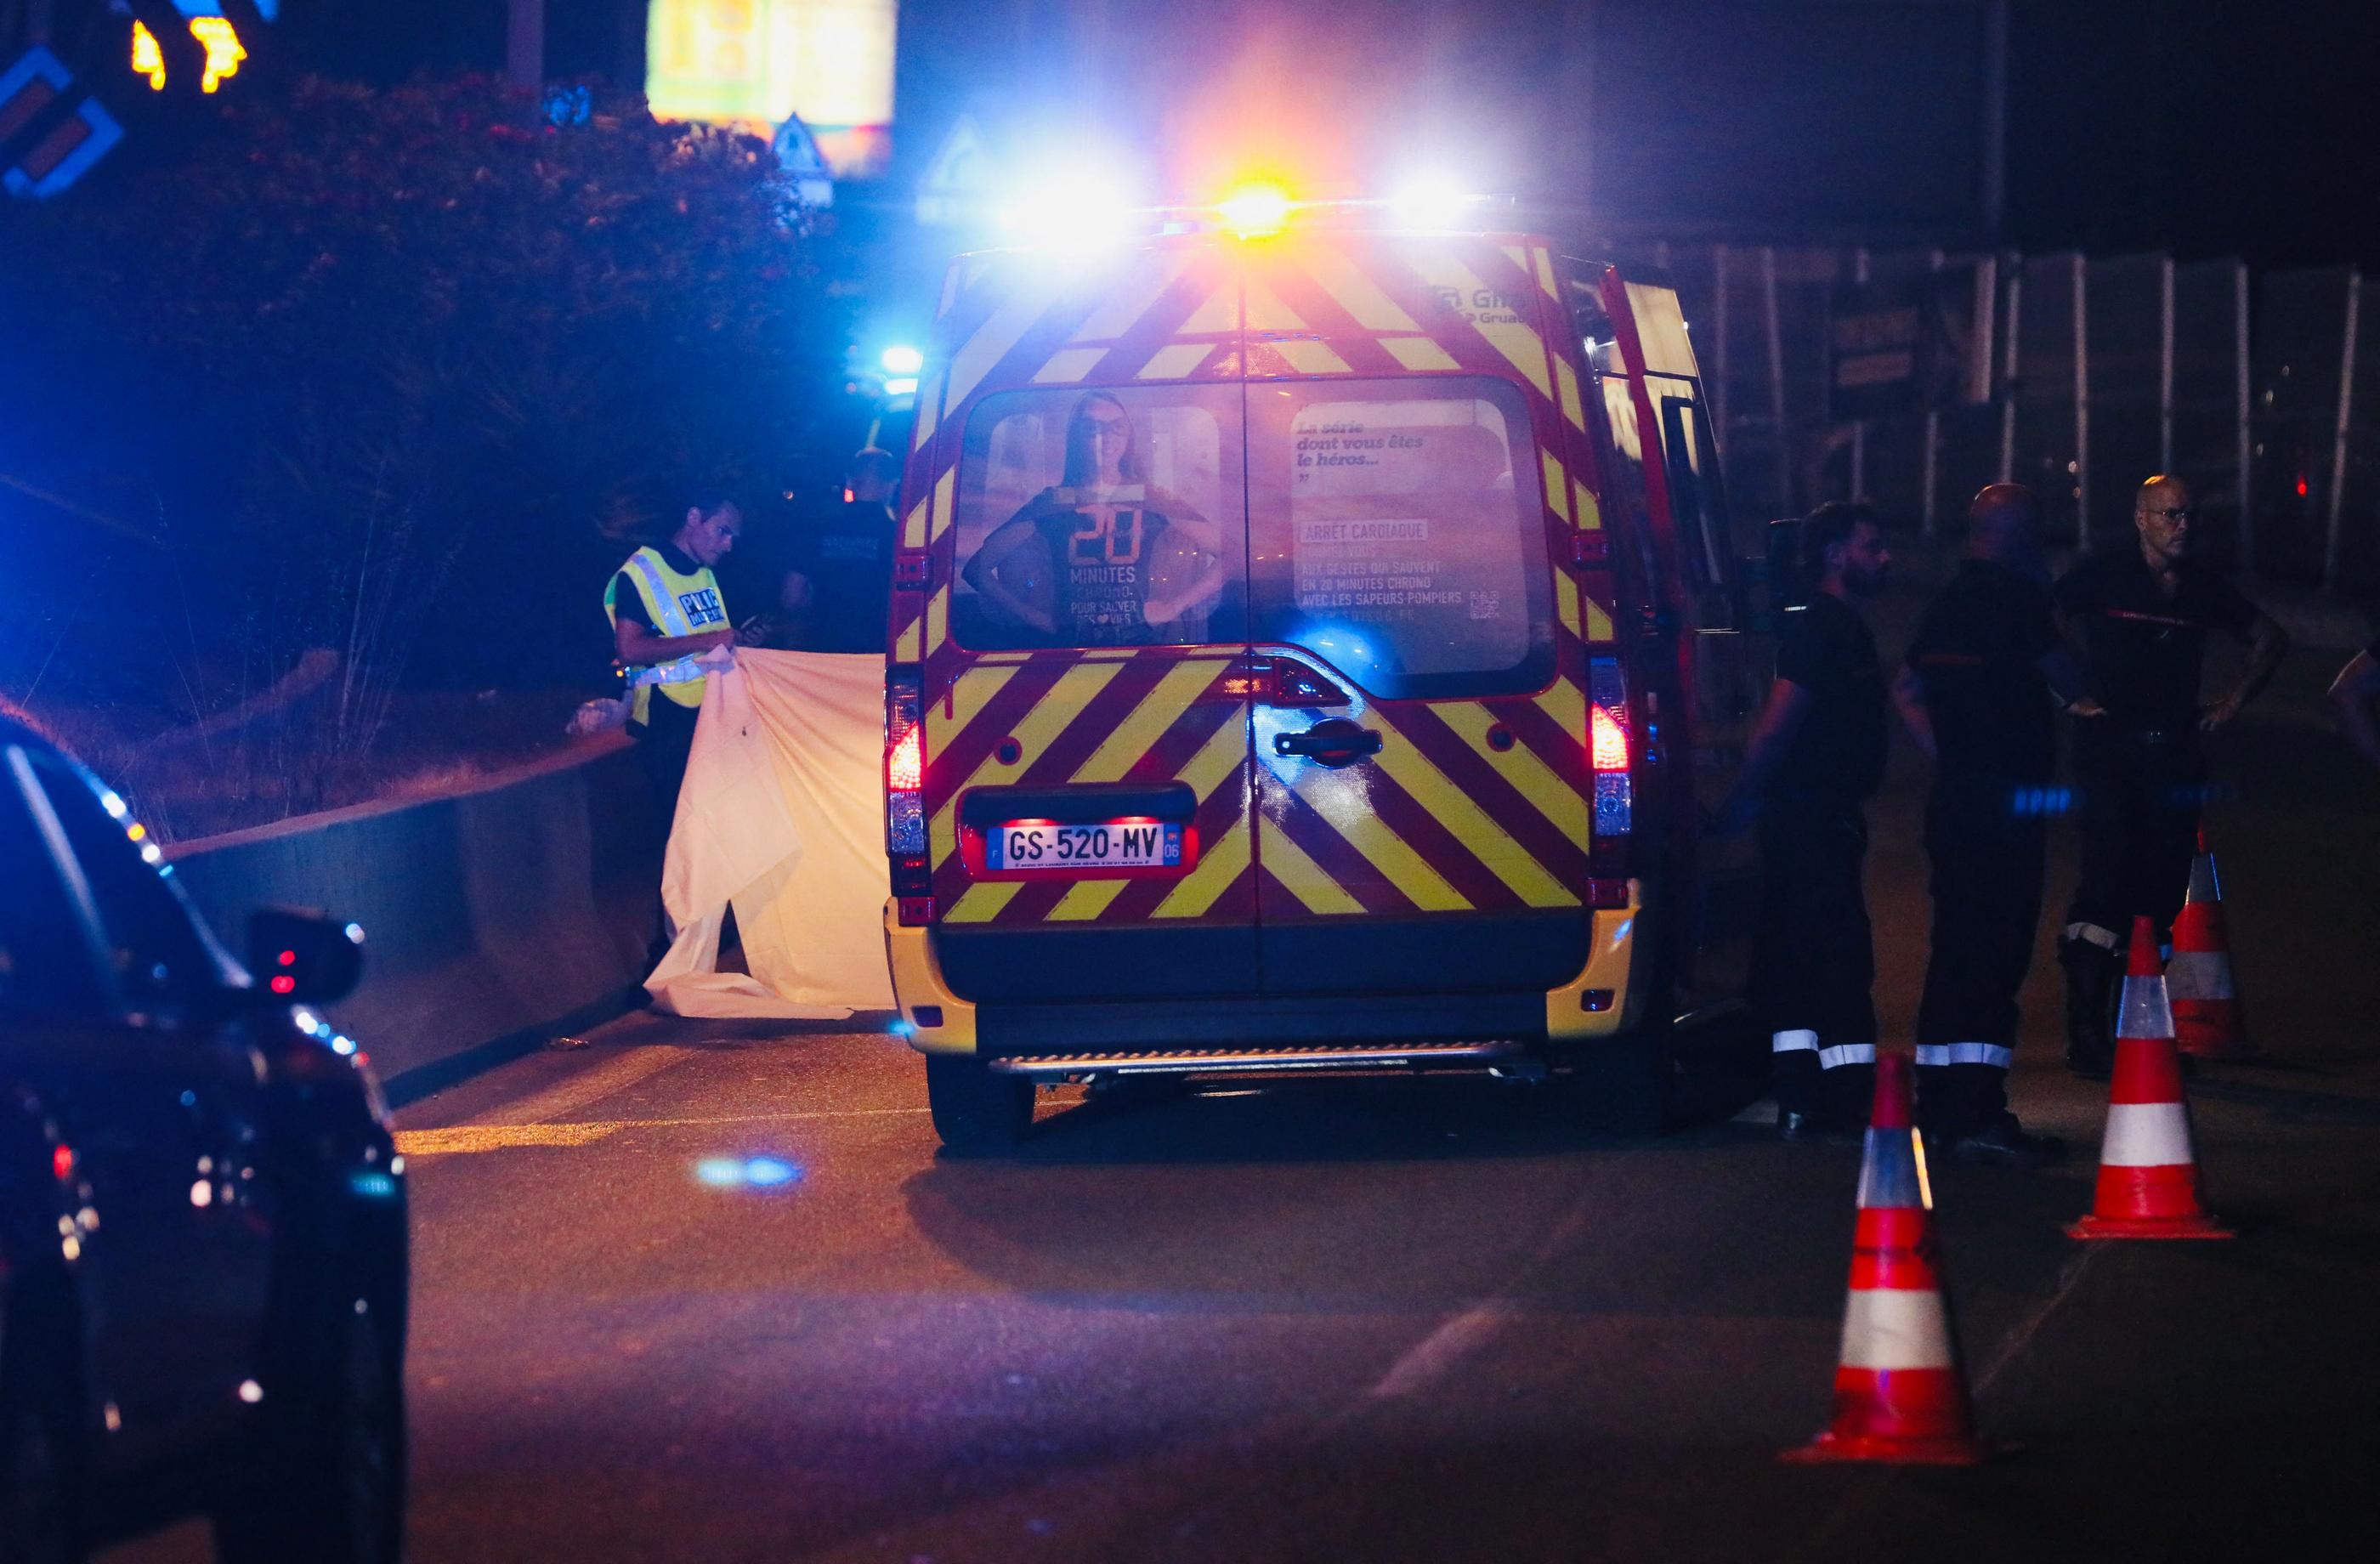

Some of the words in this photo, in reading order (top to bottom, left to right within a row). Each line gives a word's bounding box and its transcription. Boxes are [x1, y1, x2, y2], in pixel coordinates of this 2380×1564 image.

[1321, 421, 1364, 434] série
[1296, 437, 1340, 450] dont
[1343, 438, 1386, 450] vous
[1388, 434, 1424, 449] êtes
[1297, 453, 1313, 467] le
[1317, 452, 1380, 467] héros...
[1068, 502, 1143, 564] 20
[1352, 523, 1424, 540] CARDIAQUE
[1071, 566, 1136, 584] MINUTES
[1327, 563, 1367, 575] GESTES
[1370, 562, 1389, 574] QUI
[1392, 560, 1441, 574] SAUVENT
[1302, 579, 1316, 592] EN
[1320, 579, 1333, 592] 20
[1336, 577, 1384, 591] MINUTES
[1387, 576, 1431, 590] CHRONO
[1302, 593, 1329, 607] AVEC
[1332, 593, 1352, 607] LES
[1356, 592, 1462, 606] SAPEURS-POMPIERS
[1071, 601, 1096, 614] POUR
[1010, 828, 1158, 860] GS-520-MV
[1164, 843, 1180, 858] 06
[992, 849, 1000, 858] F
